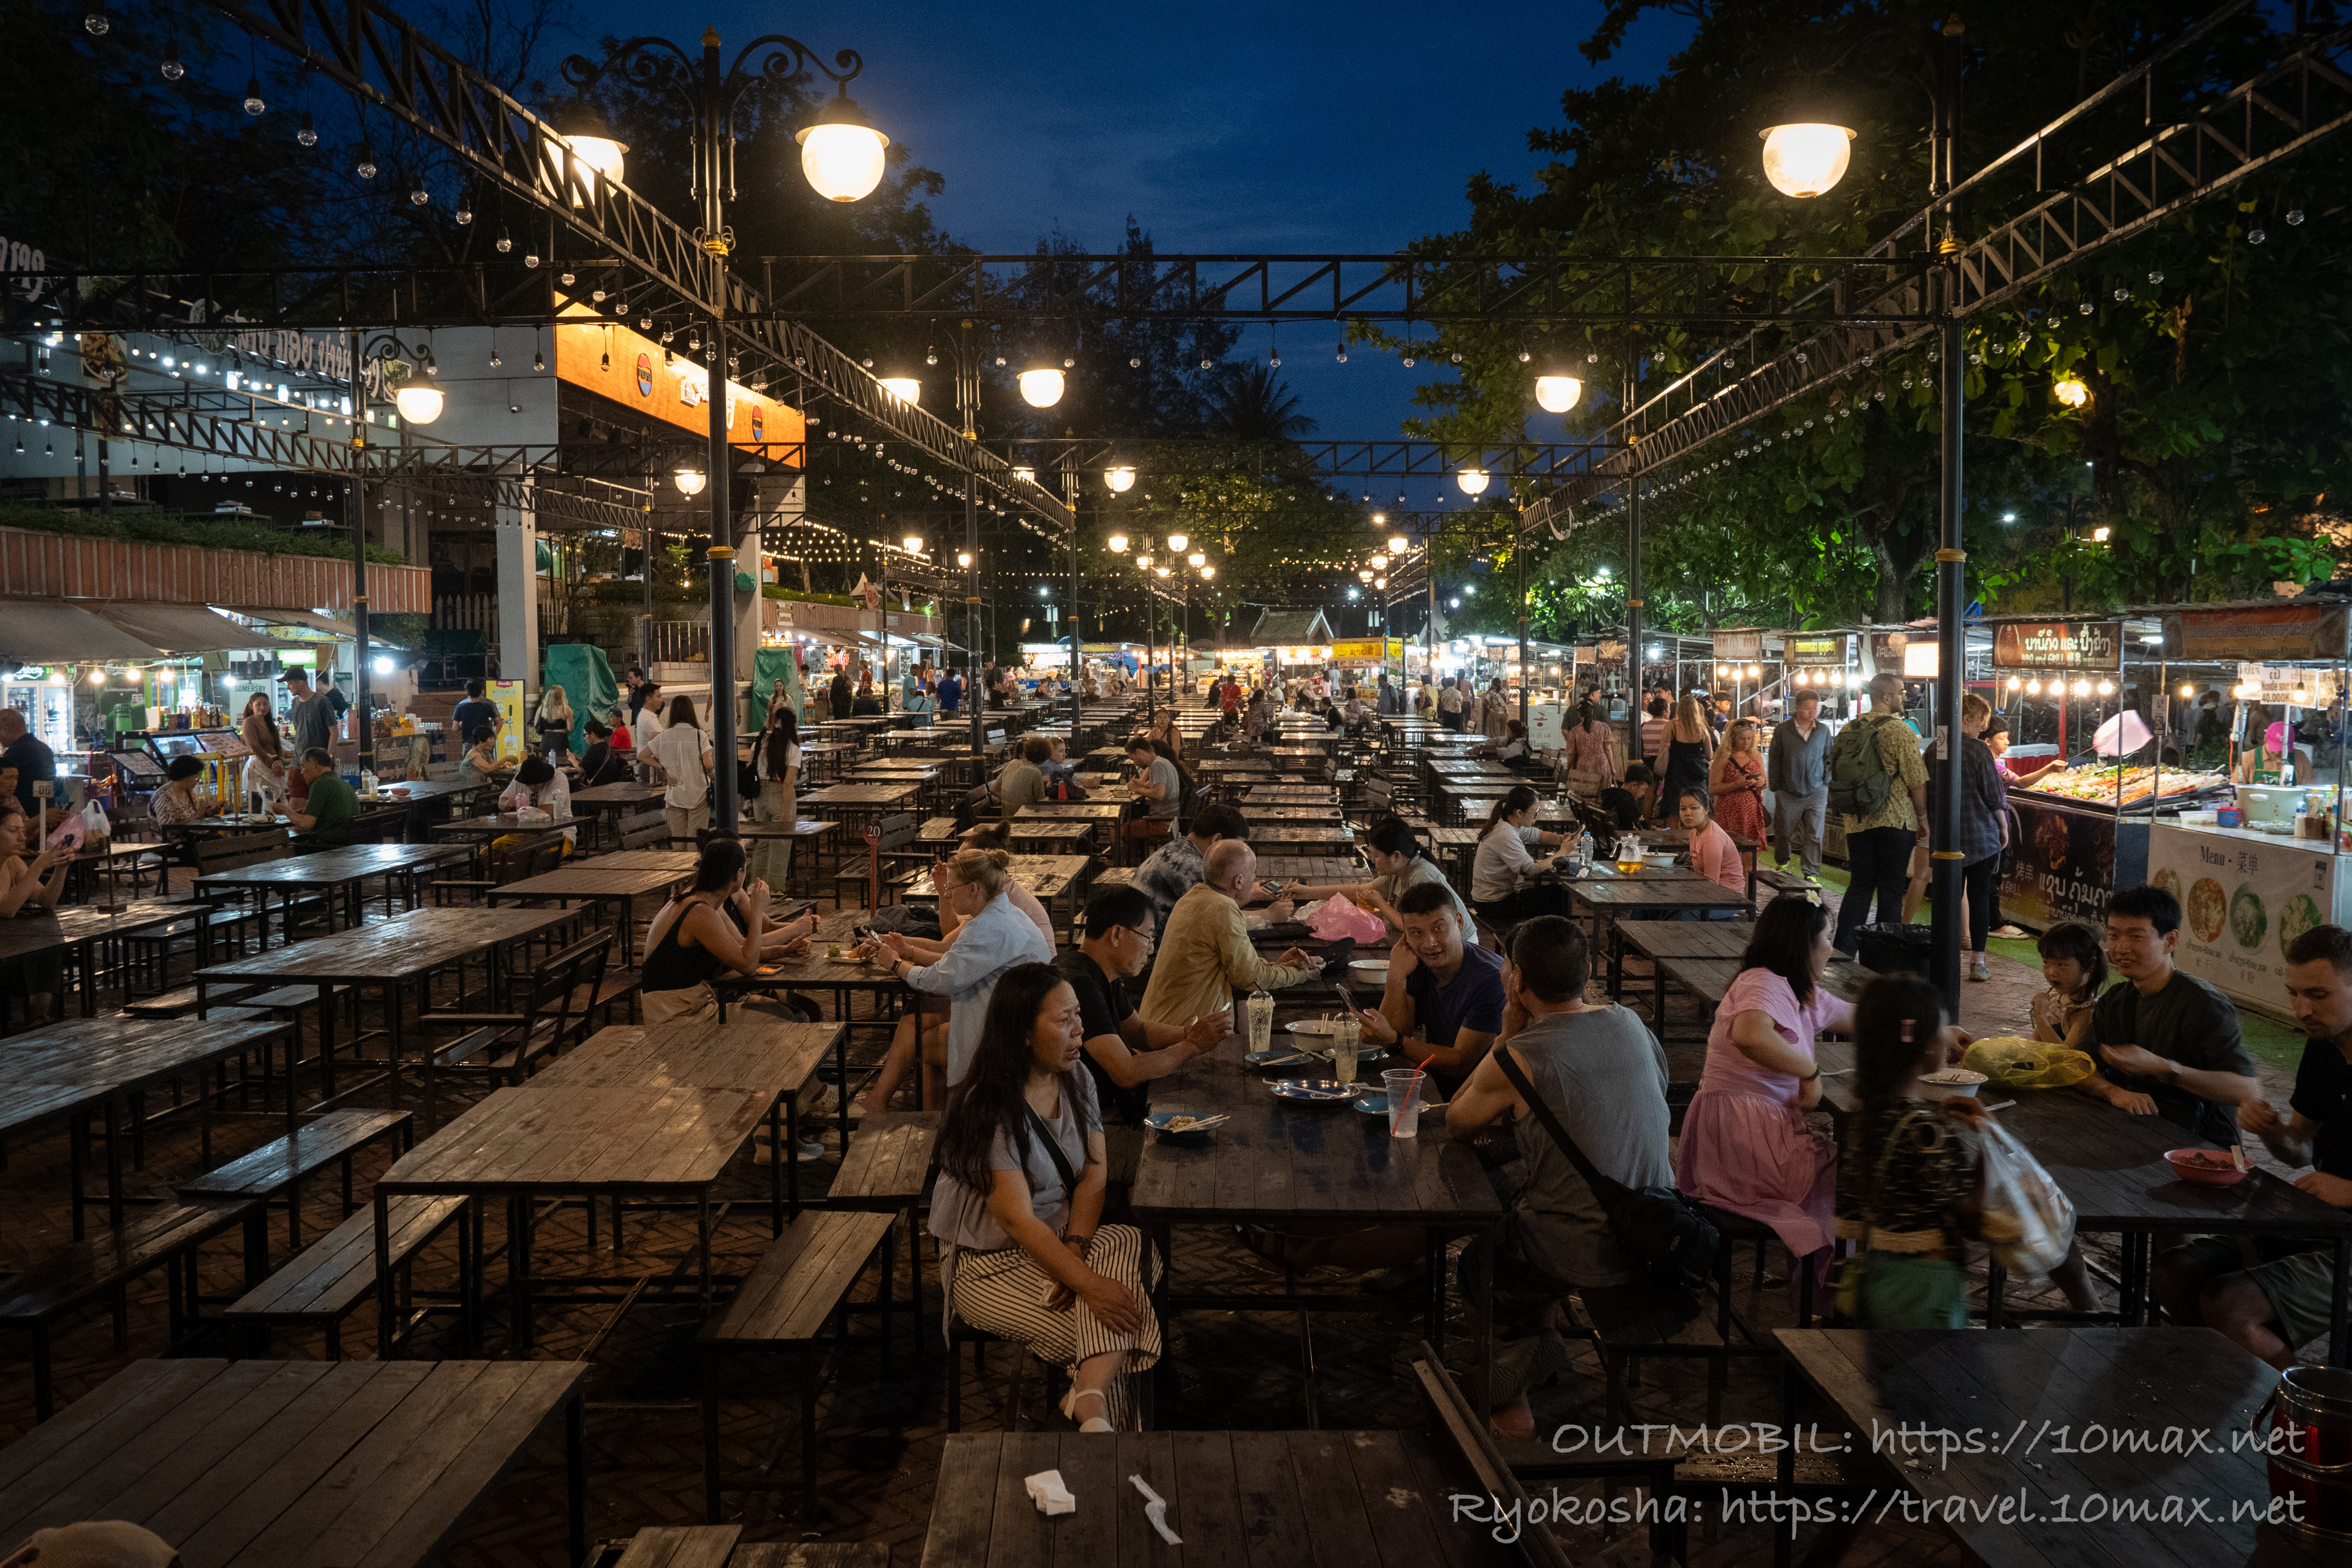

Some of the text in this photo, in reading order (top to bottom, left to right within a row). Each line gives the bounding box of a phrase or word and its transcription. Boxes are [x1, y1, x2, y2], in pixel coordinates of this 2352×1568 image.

[2060, 637, 2079, 651] ແລະ
[2035, 653, 2046, 666] and
[2048, 653, 2065, 665] GRILL
[2261, 680, 2278, 692] Noodle
[39, 785, 51, 795] 06
[2199, 845, 2225, 867] Menu
[2236, 850, 2258, 876] 菜单
[2016, 859, 2034, 883] 烤串
